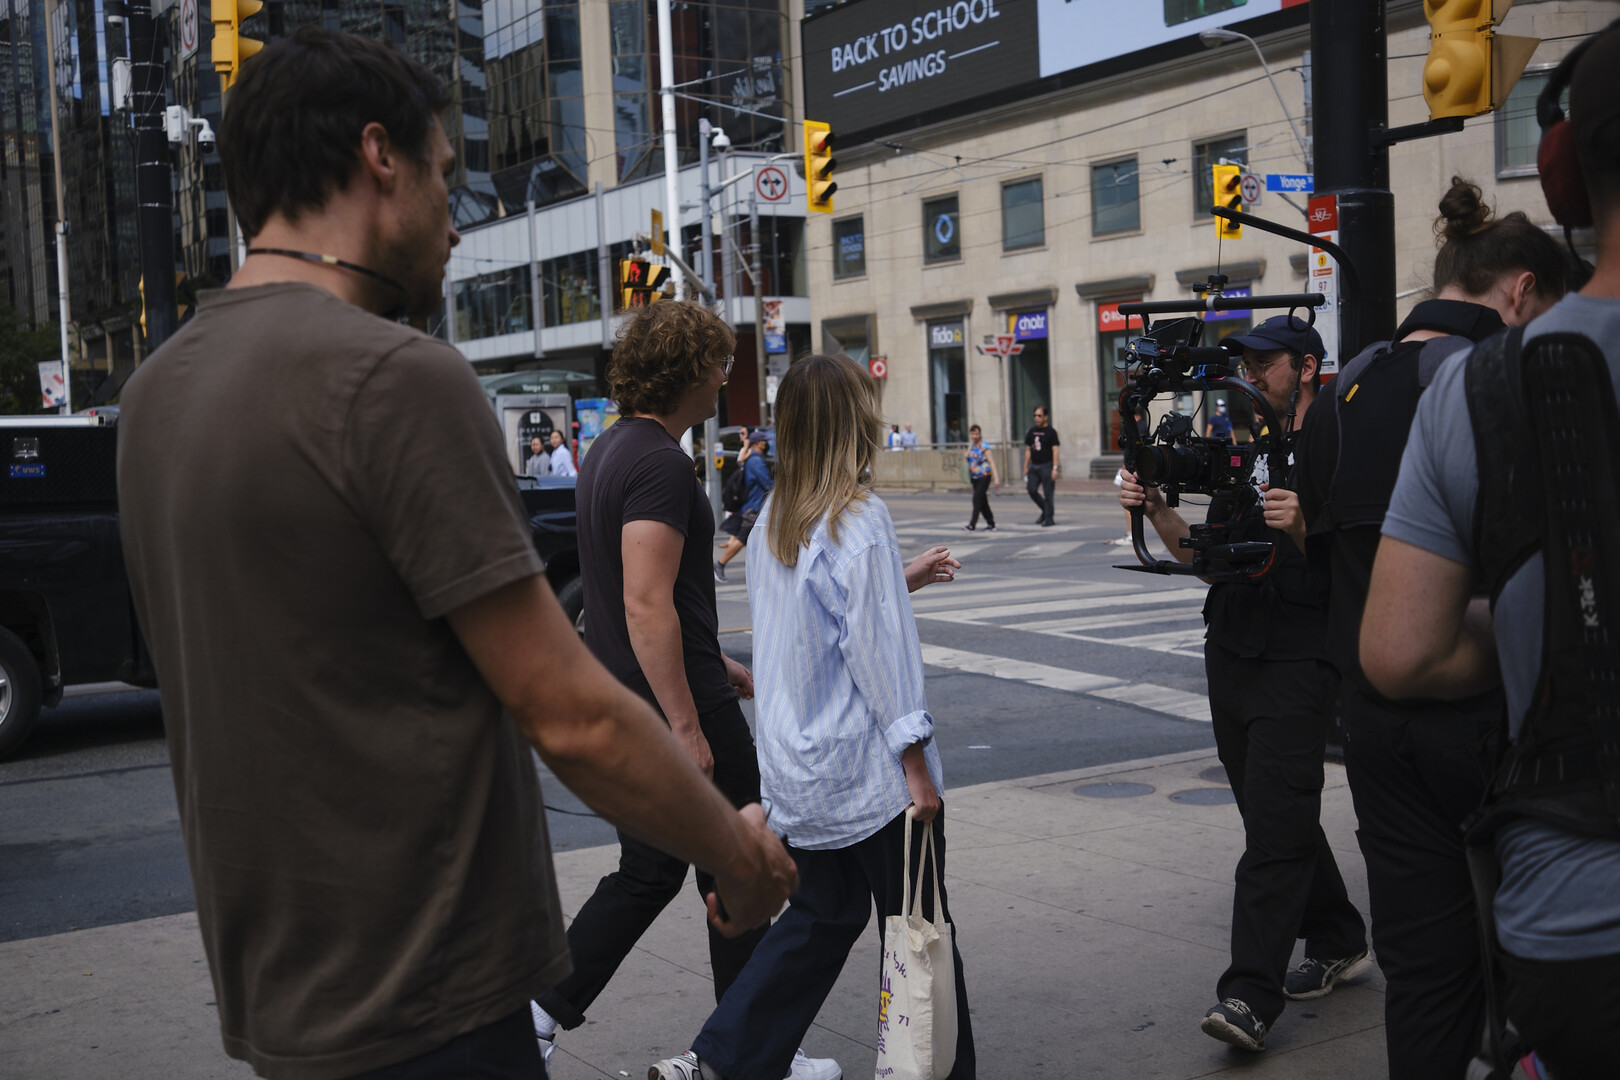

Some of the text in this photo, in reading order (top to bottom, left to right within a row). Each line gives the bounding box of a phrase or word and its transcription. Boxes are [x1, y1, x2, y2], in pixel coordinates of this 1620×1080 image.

[831, 0, 1000, 72] BACK TO SCHOOL
[878, 50, 946, 92] SAVINGS
[1280, 175, 1307, 192] Yonge
[1318, 281, 1328, 291] 97
[1018, 315, 1045, 331] chatr
[932, 327, 954, 344] fido
[522, 384, 541, 393] Yonge
[898, 1014, 910, 1027] 71
